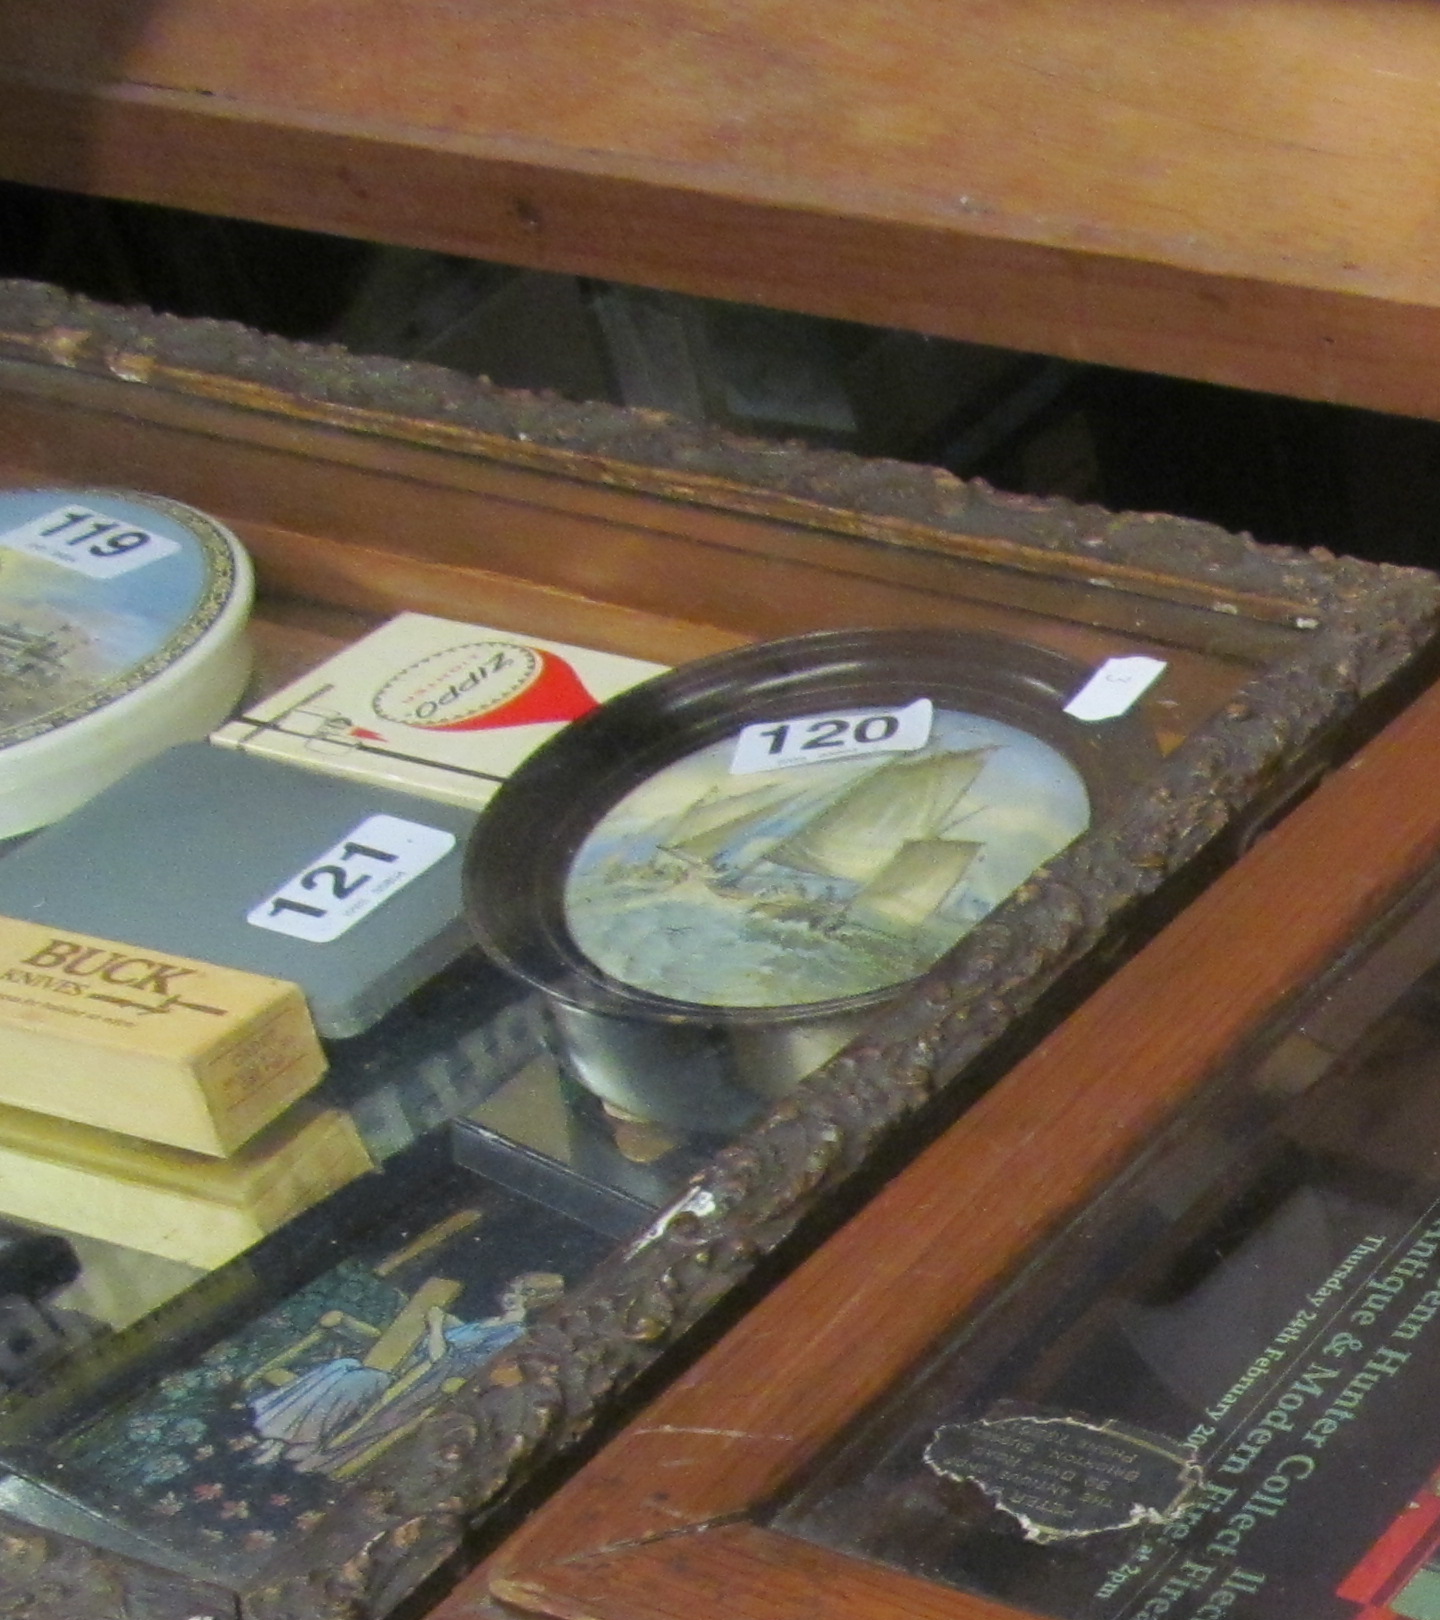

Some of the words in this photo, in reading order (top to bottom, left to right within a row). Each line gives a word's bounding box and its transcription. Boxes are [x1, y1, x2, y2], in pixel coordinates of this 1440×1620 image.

[39, 512, 150, 556] 119
[415, 651, 515, 718] ZIPPO
[760, 716, 899, 755] 120
[267, 841, 400, 918] 121
[20, 938, 199, 995] BUCK
[1307, 1235, 1387, 1310] Thursday
[1276, 1310, 1318, 1345] 24th
[1323, 1332, 1363, 1360] &
[1205, 1347, 1284, 1422] February
[1303, 1346, 1413, 1450] Hunter
[1222, 1362, 1340, 1475] Modern
[1096, 1563, 1140, 1600] 2pm
